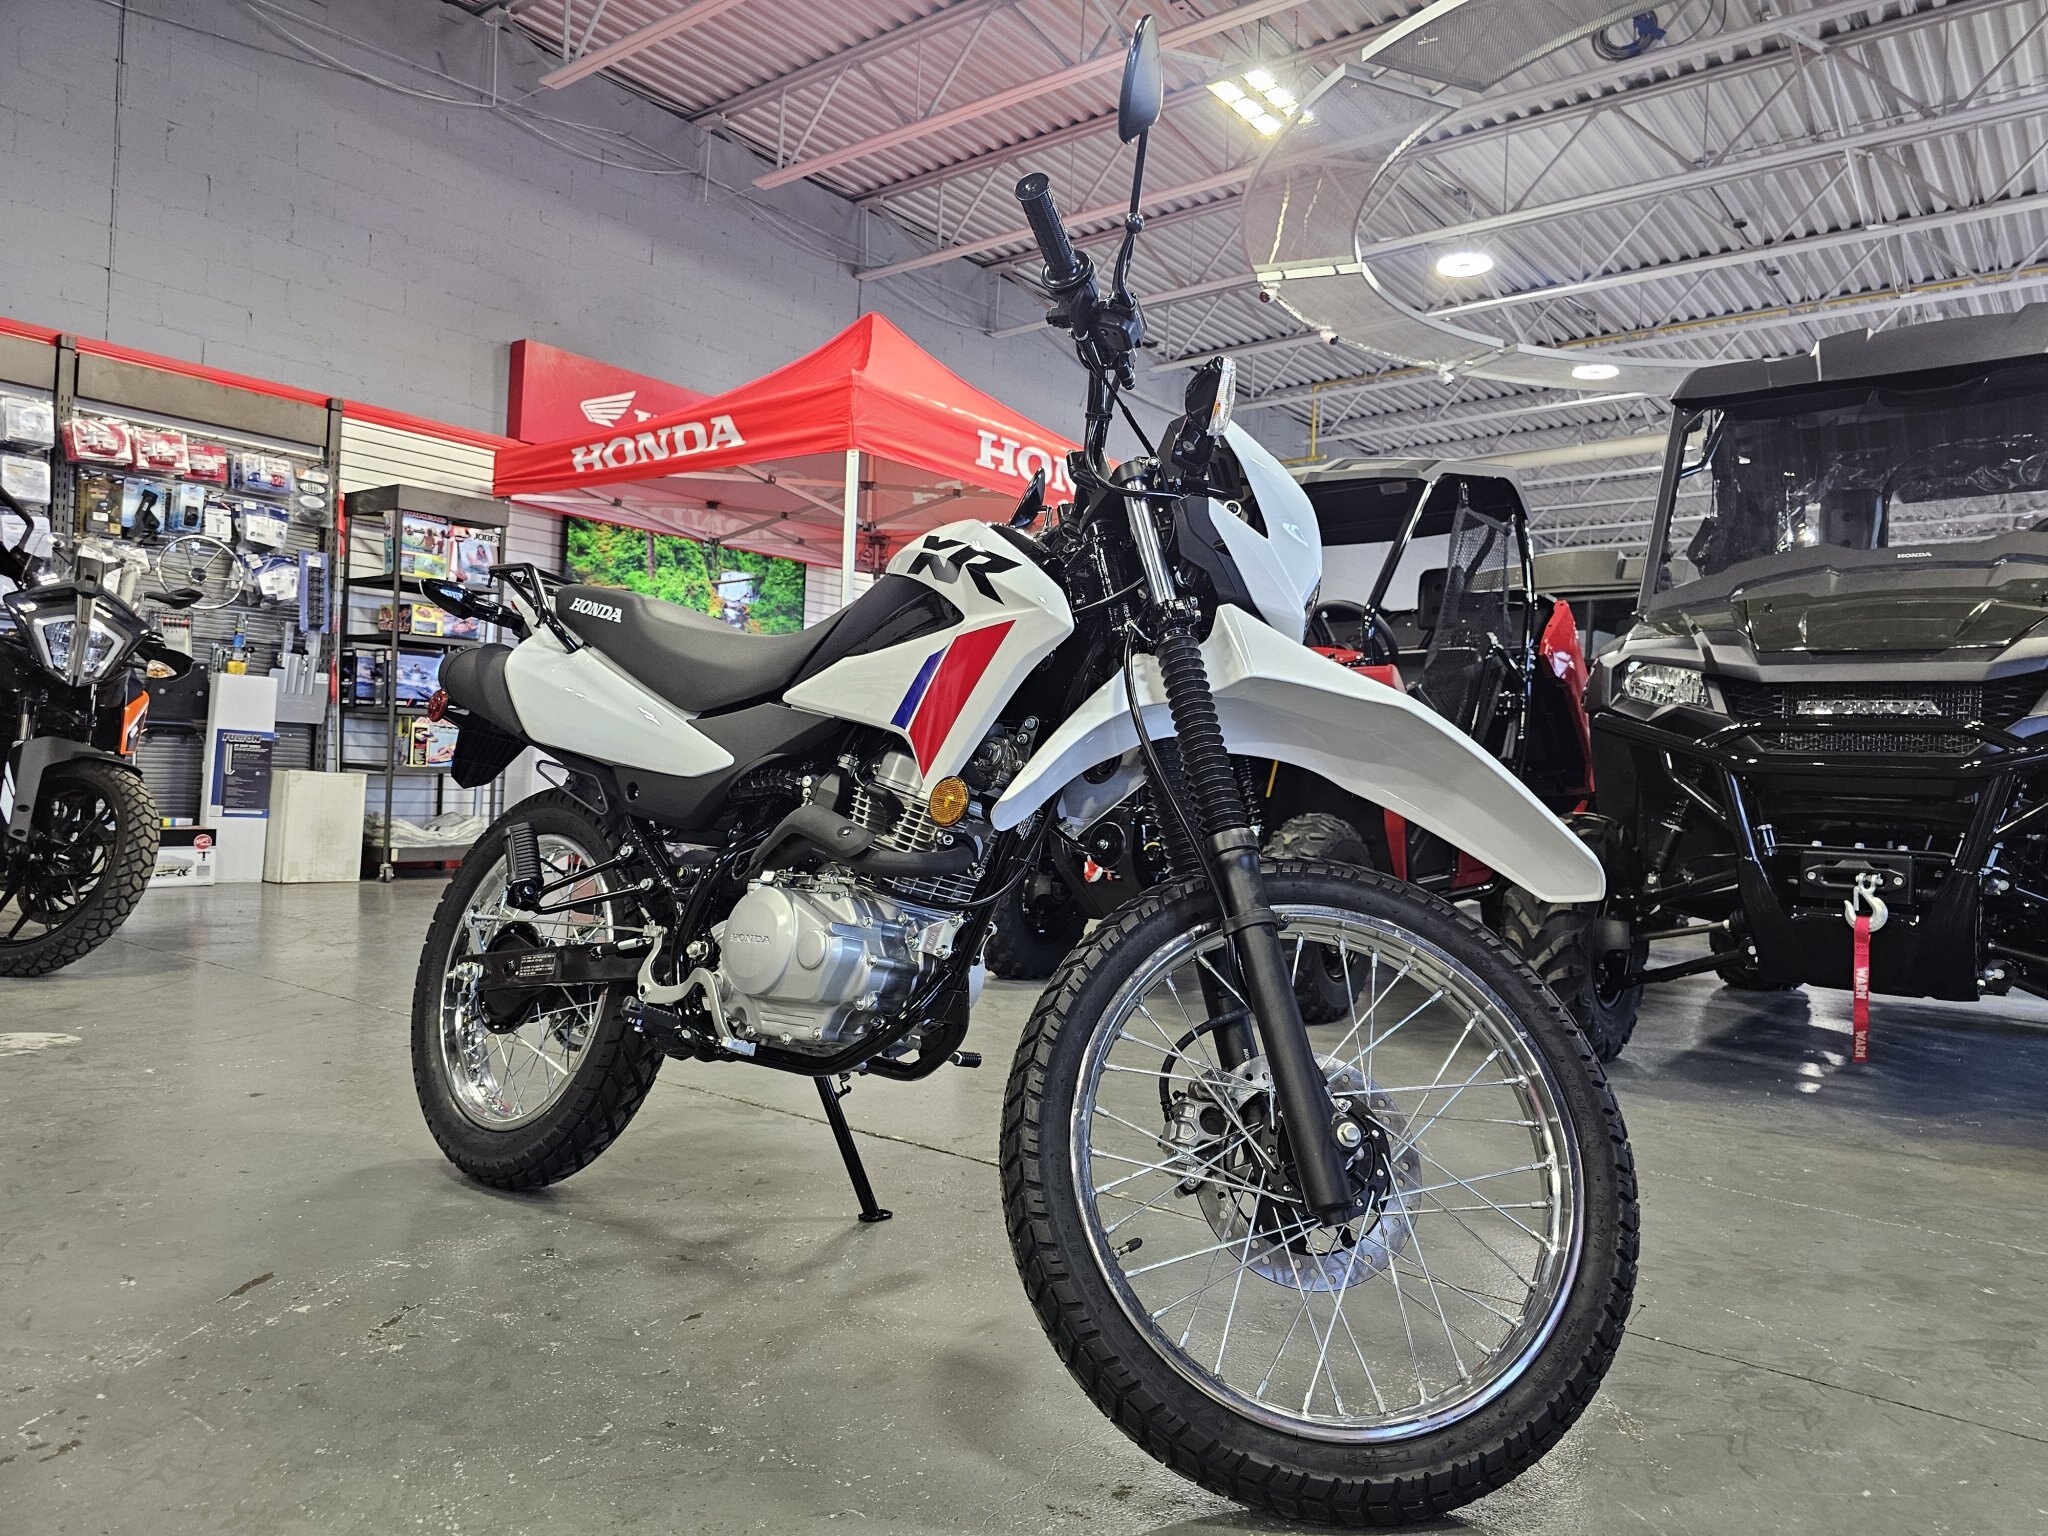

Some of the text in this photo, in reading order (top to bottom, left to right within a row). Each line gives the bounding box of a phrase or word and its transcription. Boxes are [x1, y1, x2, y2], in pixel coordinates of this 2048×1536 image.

[571, 415, 746, 473] HONDA
[907, 536, 1022, 605] XR
[569, 598, 622, 623] HONDA
[1796, 700, 1942, 715] HONDA
[729, 933, 771, 945] HONDA
[1856, 967, 1869, 999] WARN
[1855, 1030, 1867, 1058] WARN
